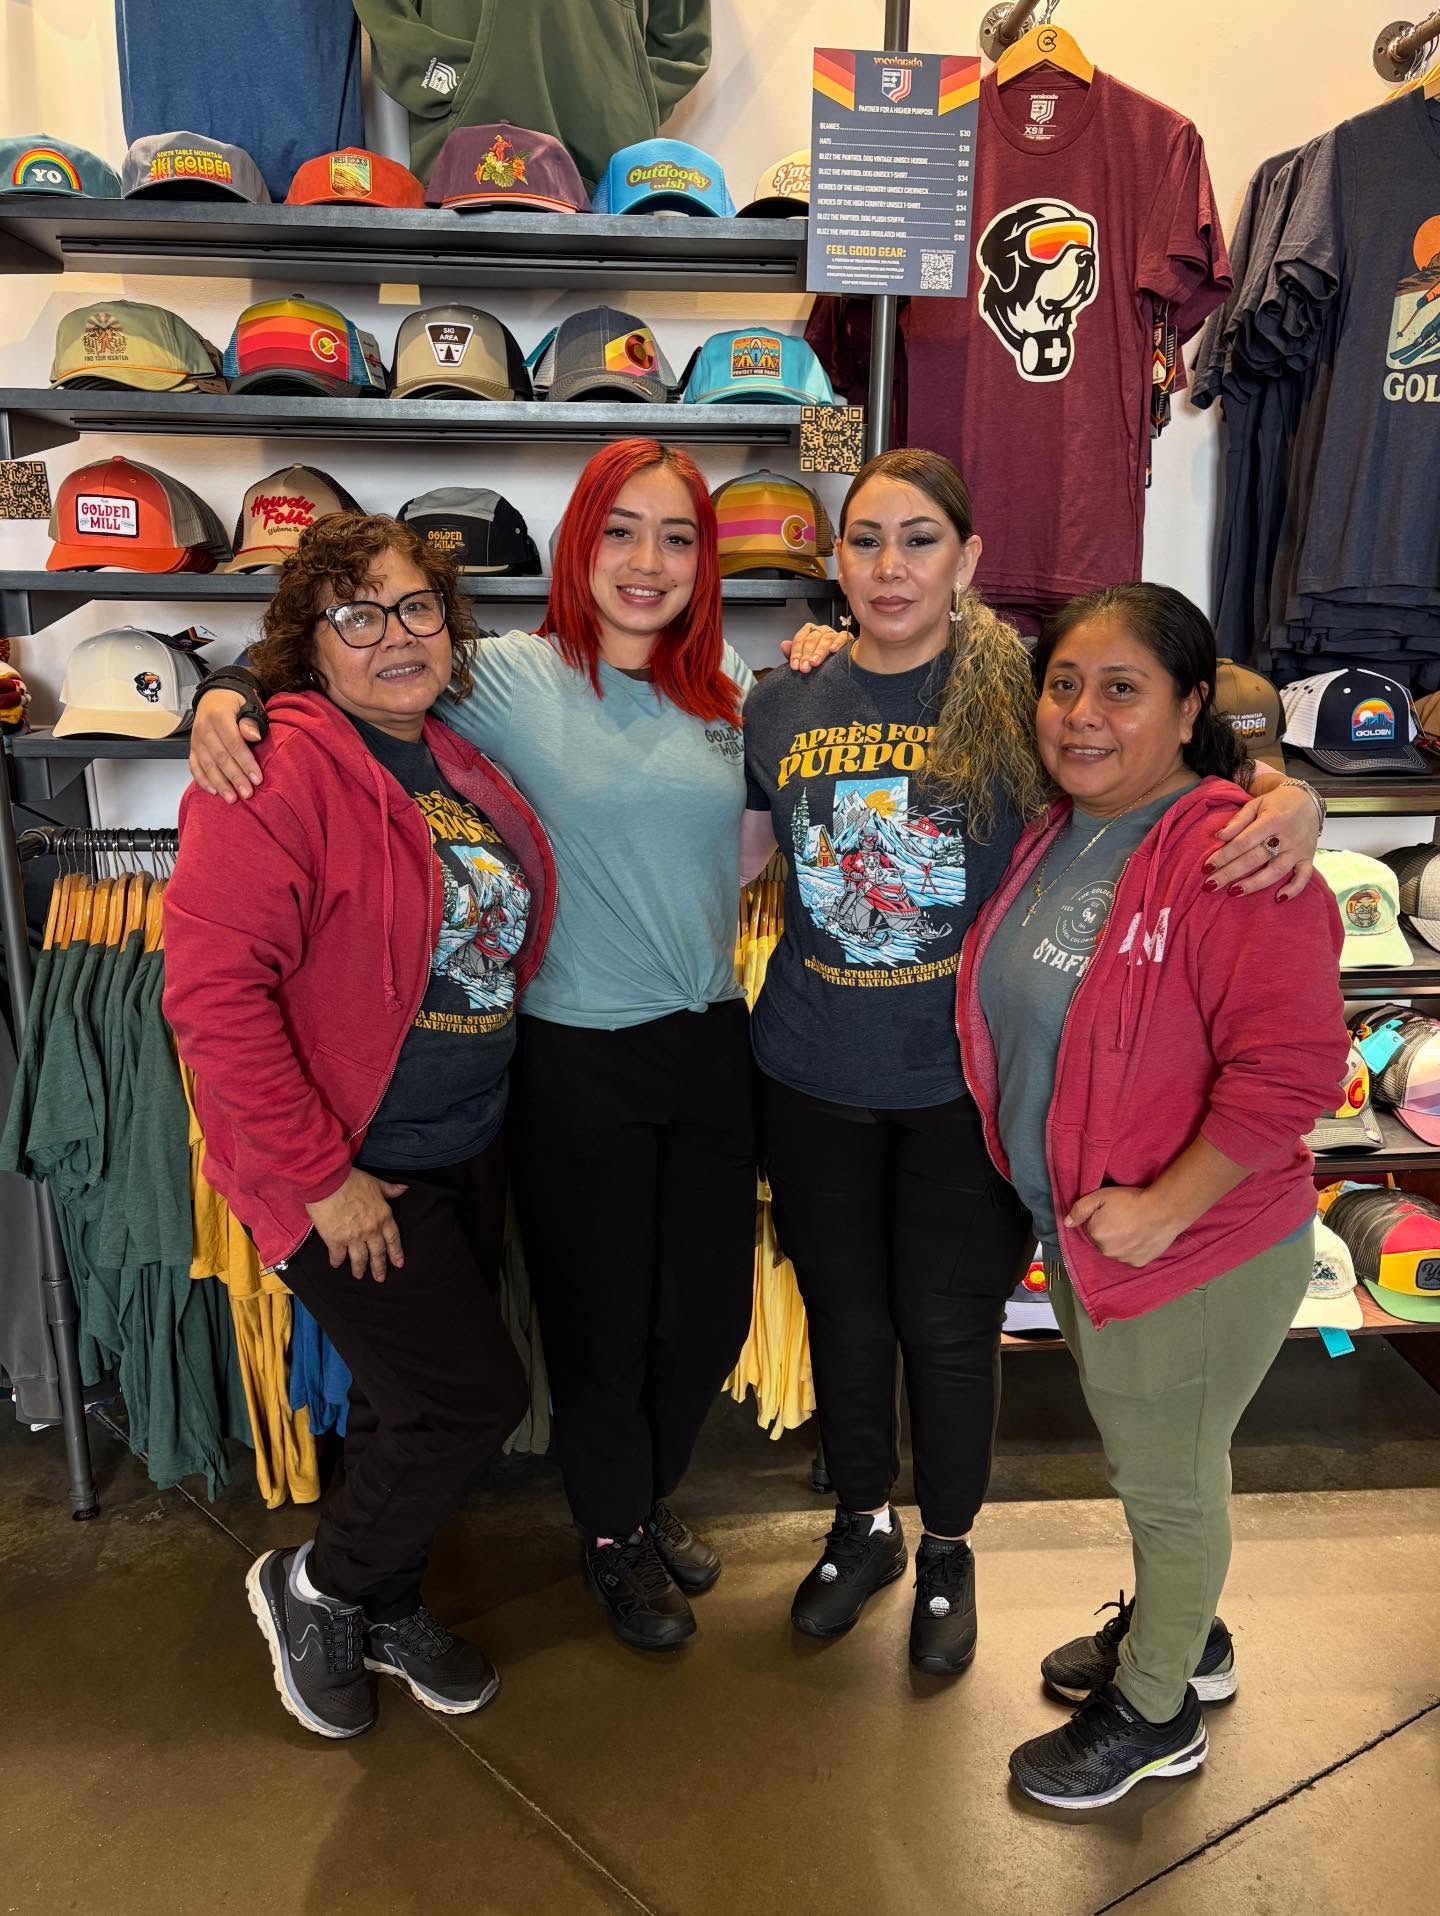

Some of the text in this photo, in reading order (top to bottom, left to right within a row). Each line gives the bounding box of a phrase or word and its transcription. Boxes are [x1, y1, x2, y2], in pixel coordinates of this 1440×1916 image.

[858, 105, 879, 113] PARTNER
[894, 107, 911, 115] HIGHER
[912, 108, 934, 116] PURPOSE
[819, 122, 840, 130] BEANIES
[1025, 127, 1038, 135] XS
[31, 168, 62, 184] YO
[150, 156, 233, 184] SKI GOLDEN
[628, 162, 709, 188] Outdoorsy
[826, 244, 848, 256] FEEL
[849, 246, 877, 256] GOOD
[878, 247, 907, 258] GEAR:
[1383, 372, 1440, 403] GOL
[81, 502, 130, 519] GOLDEN
[251, 494, 316, 518] Howdy
[90, 516, 121, 530] MILL
[428, 530, 462, 541] GOLDEN
[434, 540, 456, 549] MILL
[1231, 717, 1266, 738] OLDEN
[1356, 729, 1392, 737] GOLDEN
[789, 720, 882, 754] APRÈS
[777, 741, 928, 791] PURPO
[891, 952, 960, 977] CELEBRATIO
[858, 976, 914, 988] NATIONAL
[916, 971, 936, 983] SKI
[938, 963, 958, 977] PAT
[412, 1018, 478, 1034] ENEFITING
